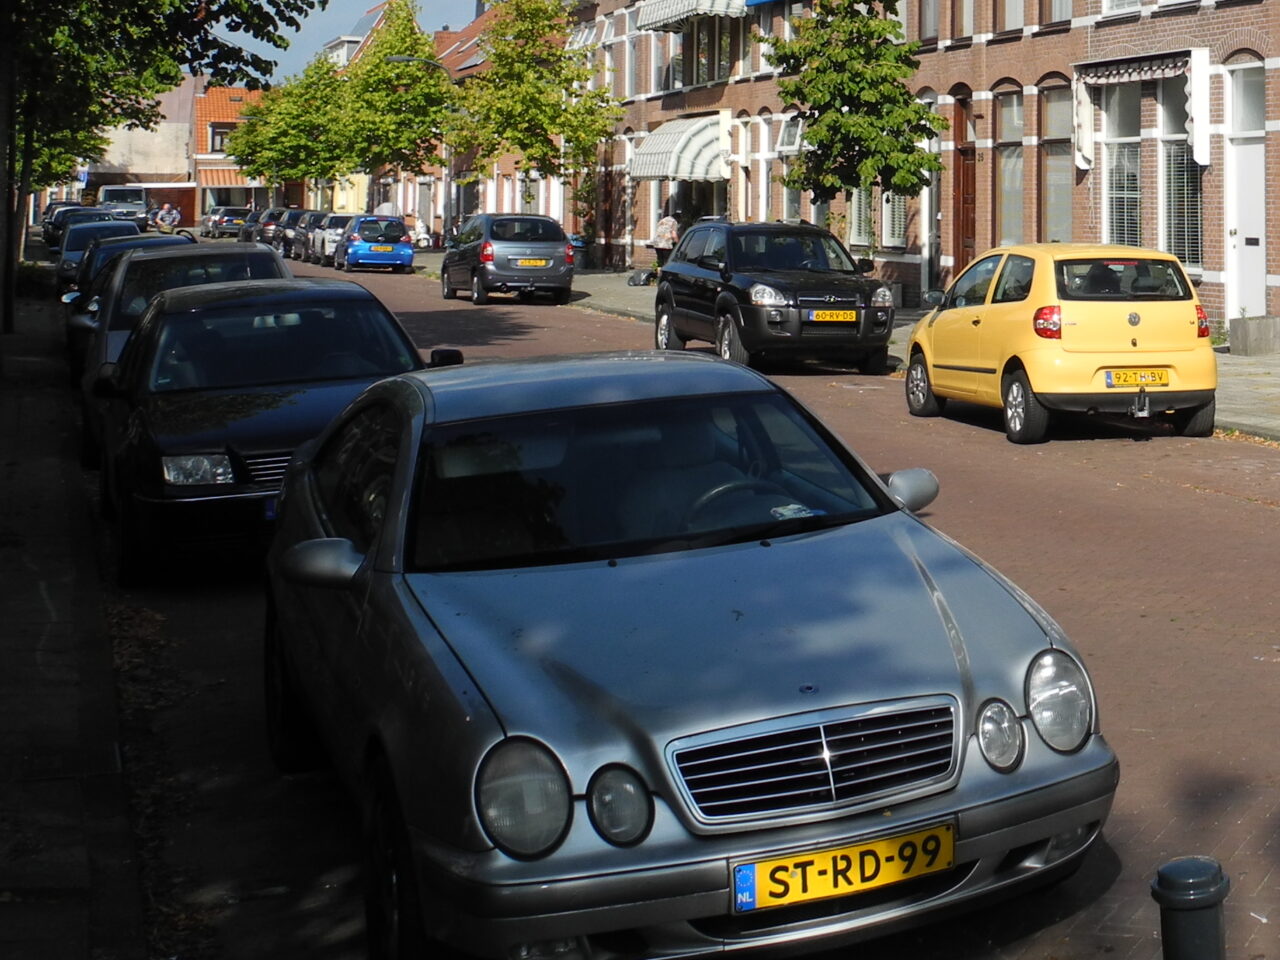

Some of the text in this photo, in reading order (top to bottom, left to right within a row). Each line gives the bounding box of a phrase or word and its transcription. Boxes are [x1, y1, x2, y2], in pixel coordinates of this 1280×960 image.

[815, 311, 855, 320] 60-RV-DS
[1114, 372, 1164, 383] 92-TH-BV
[767, 833, 942, 900] ST-RD-99
[737, 891, 753, 903] NL
